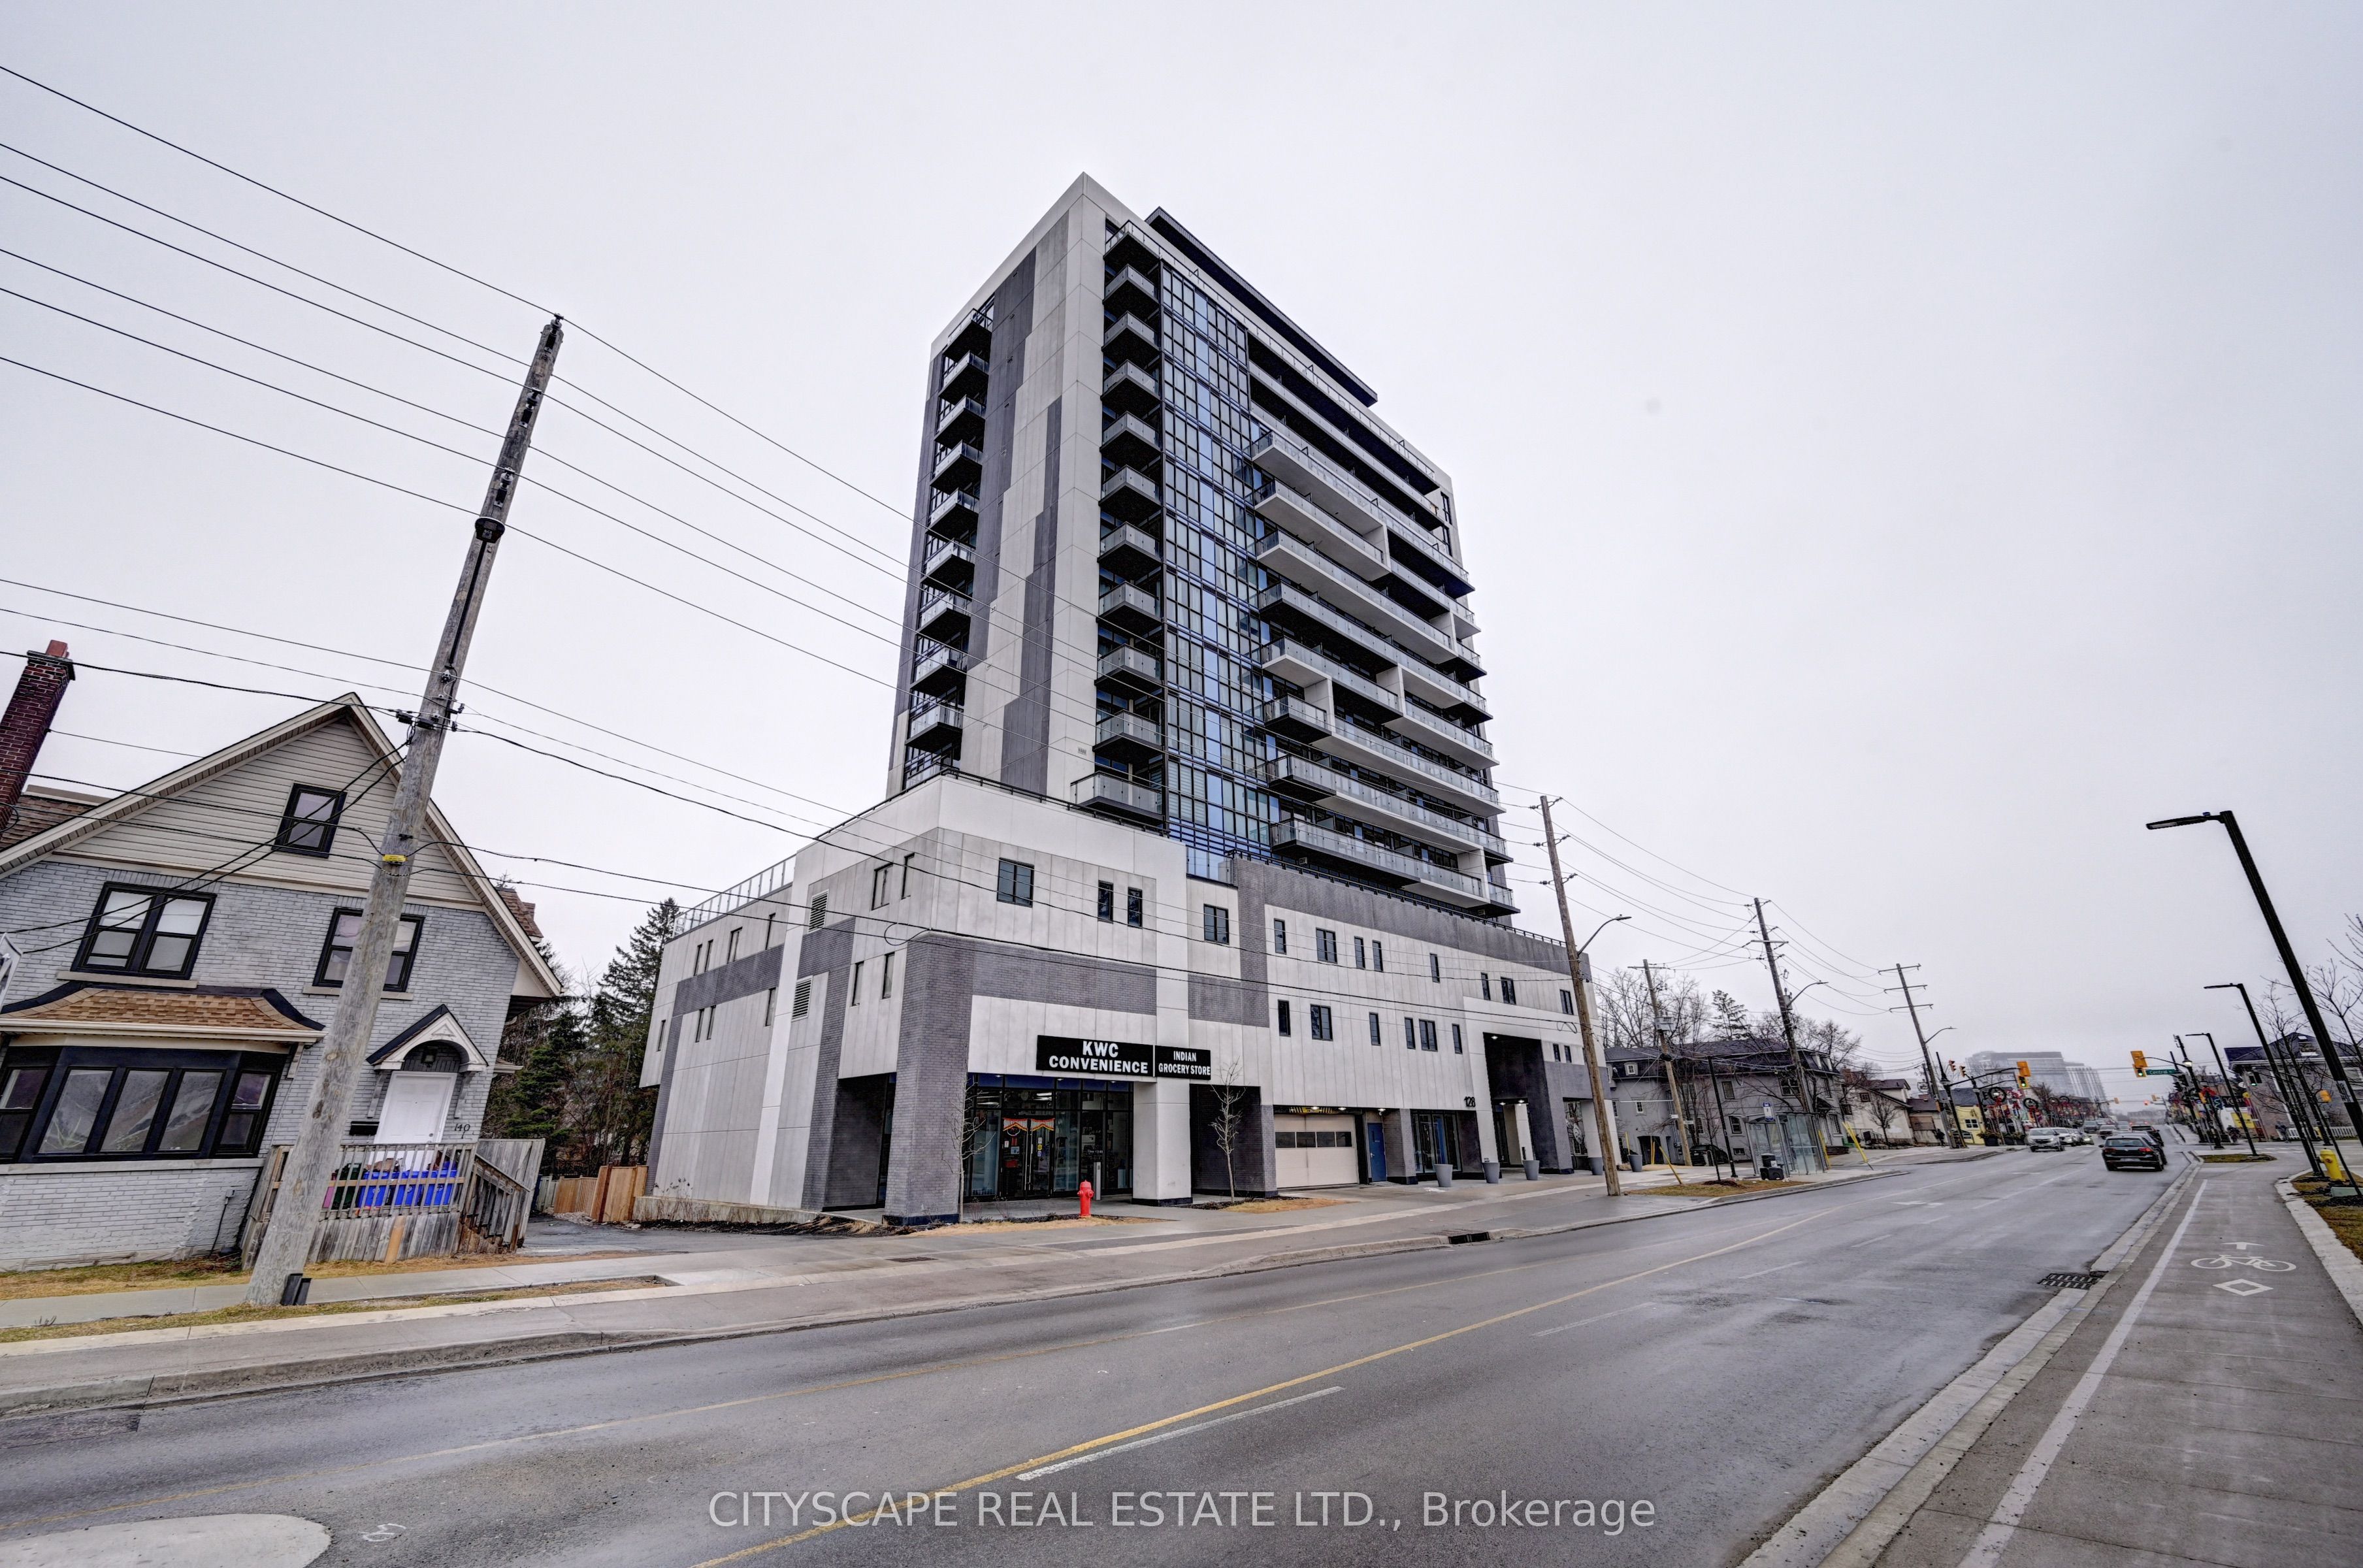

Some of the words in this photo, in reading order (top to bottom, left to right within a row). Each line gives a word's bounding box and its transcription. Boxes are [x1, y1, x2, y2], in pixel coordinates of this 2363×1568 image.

[1083, 1040, 1118, 1057] KWC
[1173, 1051, 1197, 1062] INDIAN
[1049, 1055, 1149, 1073] CONVENIENCE
[1158, 1063, 1190, 1074] GROCERY
[1190, 1064, 1211, 1075] STORE
[1463, 1096, 1476, 1107] 128
